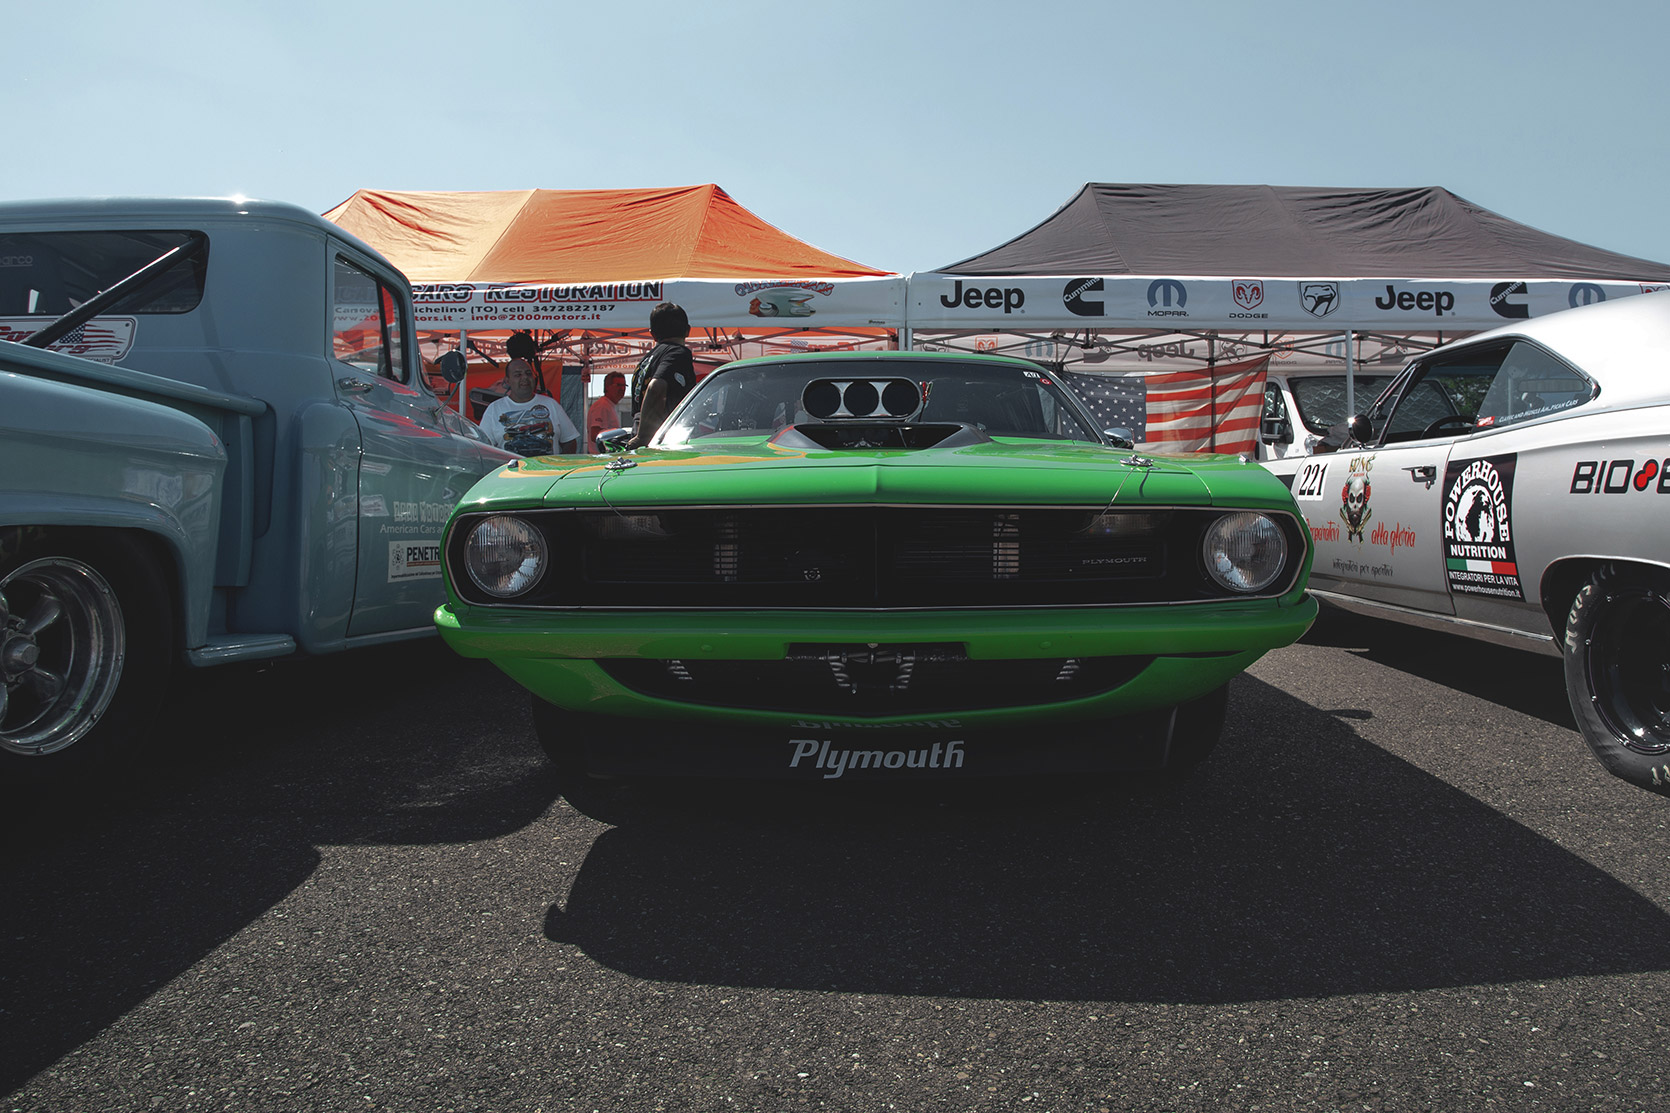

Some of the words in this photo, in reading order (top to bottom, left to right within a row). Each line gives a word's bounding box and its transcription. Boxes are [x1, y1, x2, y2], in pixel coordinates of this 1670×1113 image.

[0, 255, 33, 265] arco
[940, 280, 1024, 314] Jeep
[1064, 277, 1100, 302] Cummins
[1375, 285, 1454, 316] Jeep
[414, 305, 466, 313] ichelino
[471, 306, 498, 314] (TO)
[533, 304, 615, 313] 3472822187
[472, 313, 600, 322] info@2000motors.it
[1298, 463, 1329, 496] 221
[1444, 459, 1511, 542] POWERHOUSE
[380, 524, 418, 534] American
[420, 524, 435, 534] Cars
[406, 546, 440, 562] PENETR
[1450, 544, 1507, 559] NUTRITION
[1082, 556, 1147, 565] PLYMOUTH
[1449, 571, 1483, 583] INTEGRATORI
[1484, 574, 1495, 584] PER
[1496, 575, 1504, 585] LA
[1504, 576, 1519, 586] VITA
[1452, 583, 1521, 598] www.powerhousenutrition.it
[788, 740, 964, 779] Plymouth
